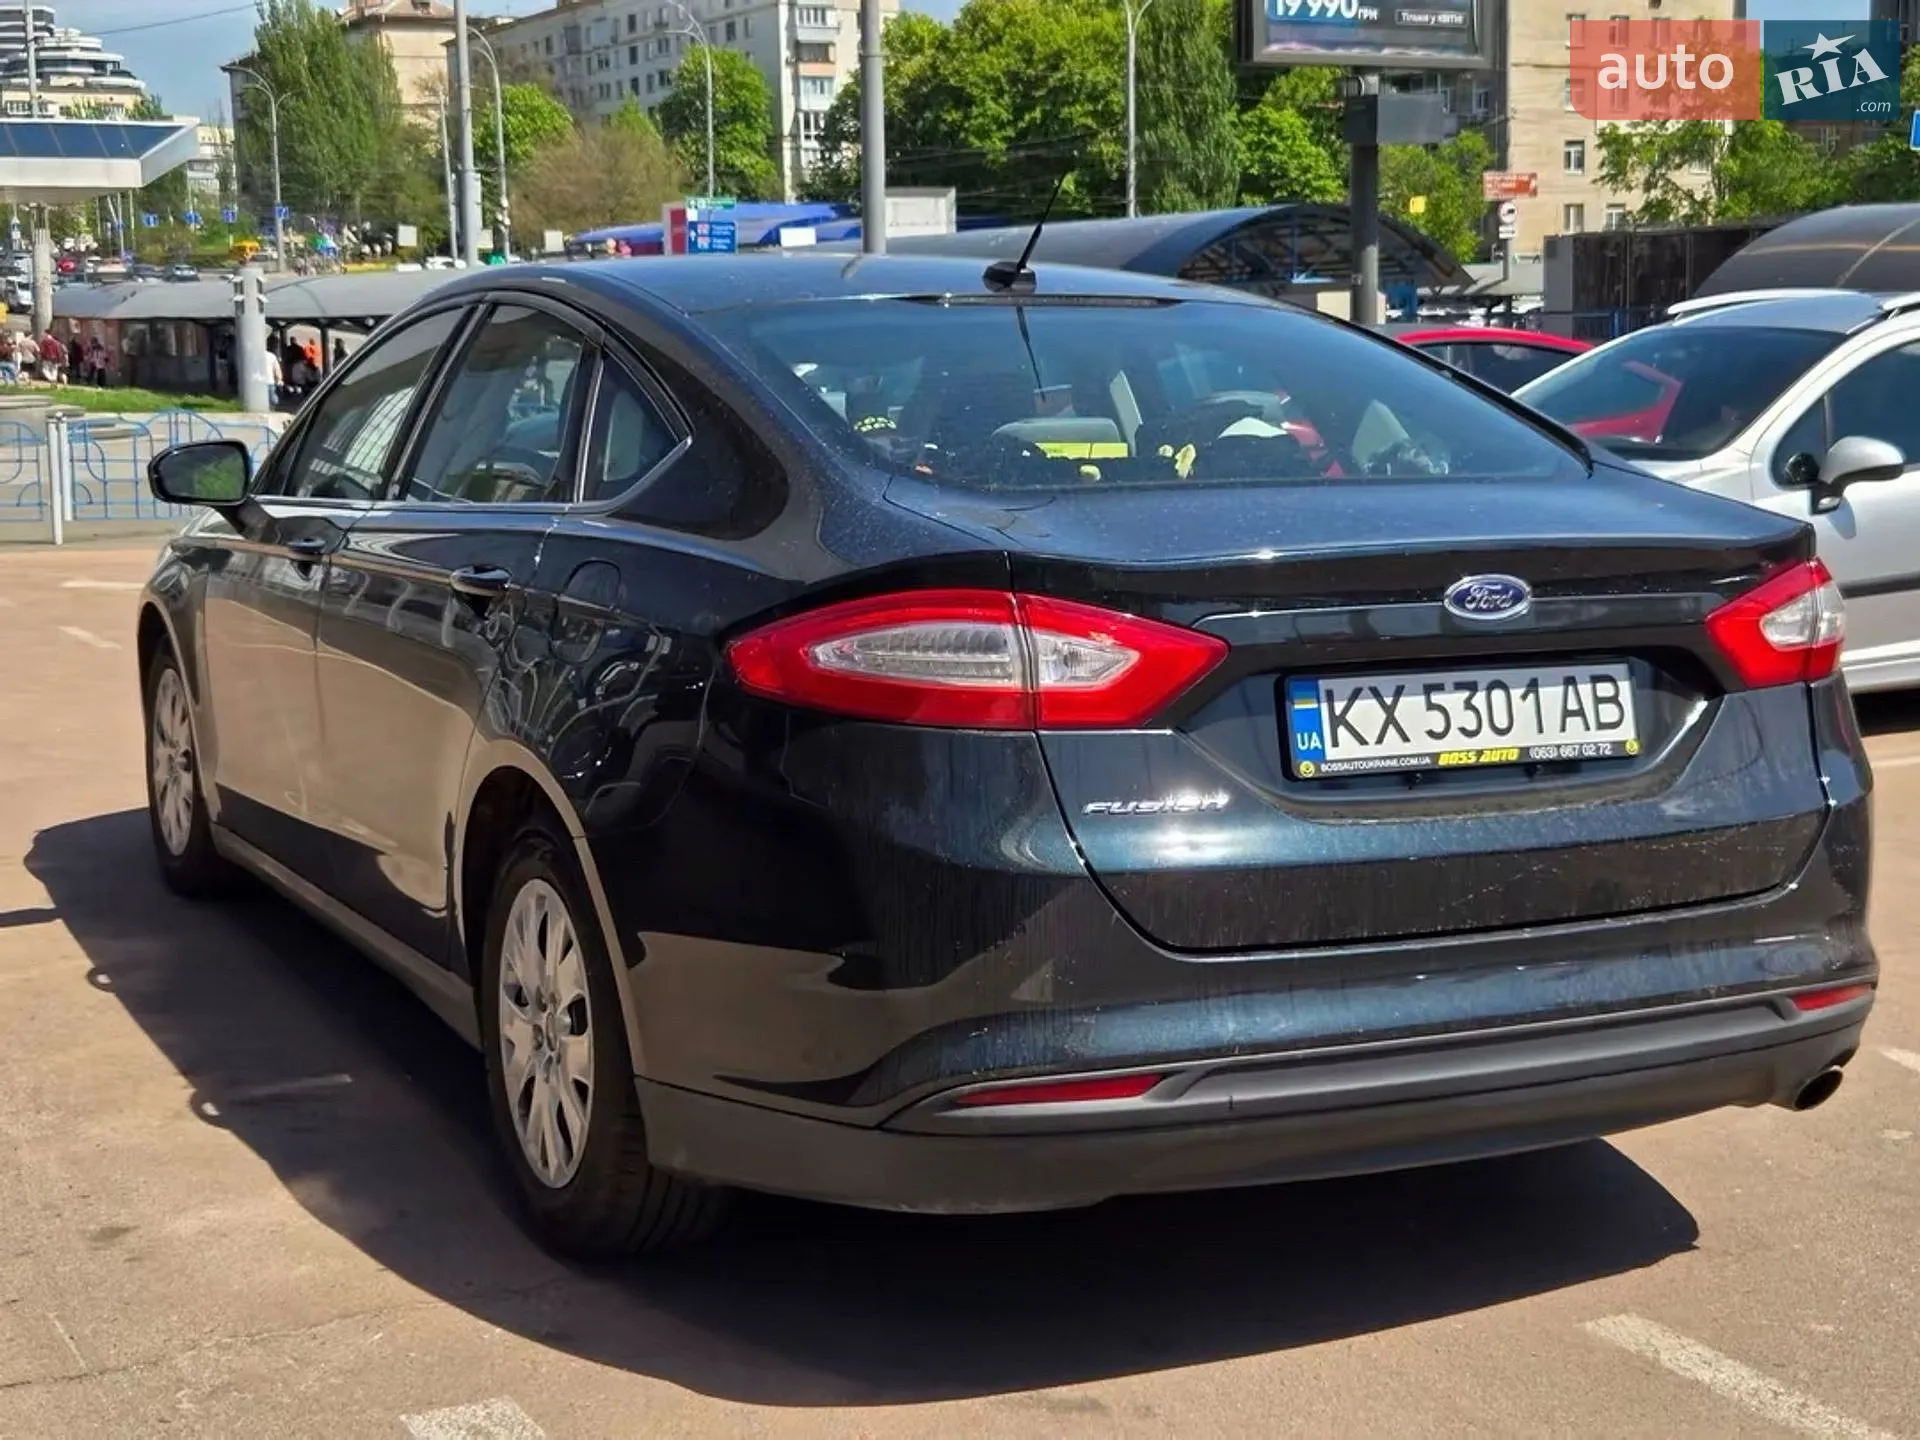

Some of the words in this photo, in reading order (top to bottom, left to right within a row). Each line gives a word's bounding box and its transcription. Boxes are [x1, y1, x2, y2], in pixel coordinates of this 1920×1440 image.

[1464, 584, 1514, 610] Ford
[1325, 683, 1412, 748] KX
[1423, 677, 1544, 741] 5301
[1560, 673, 1625, 734] AB
[1297, 732, 1322, 751] UA
[1438, 751, 1477, 766] BOSS
[1480, 748, 1520, 762] AUTO
[1598, 743, 1612, 755] 72
[1082, 791, 1230, 816] FUSION
